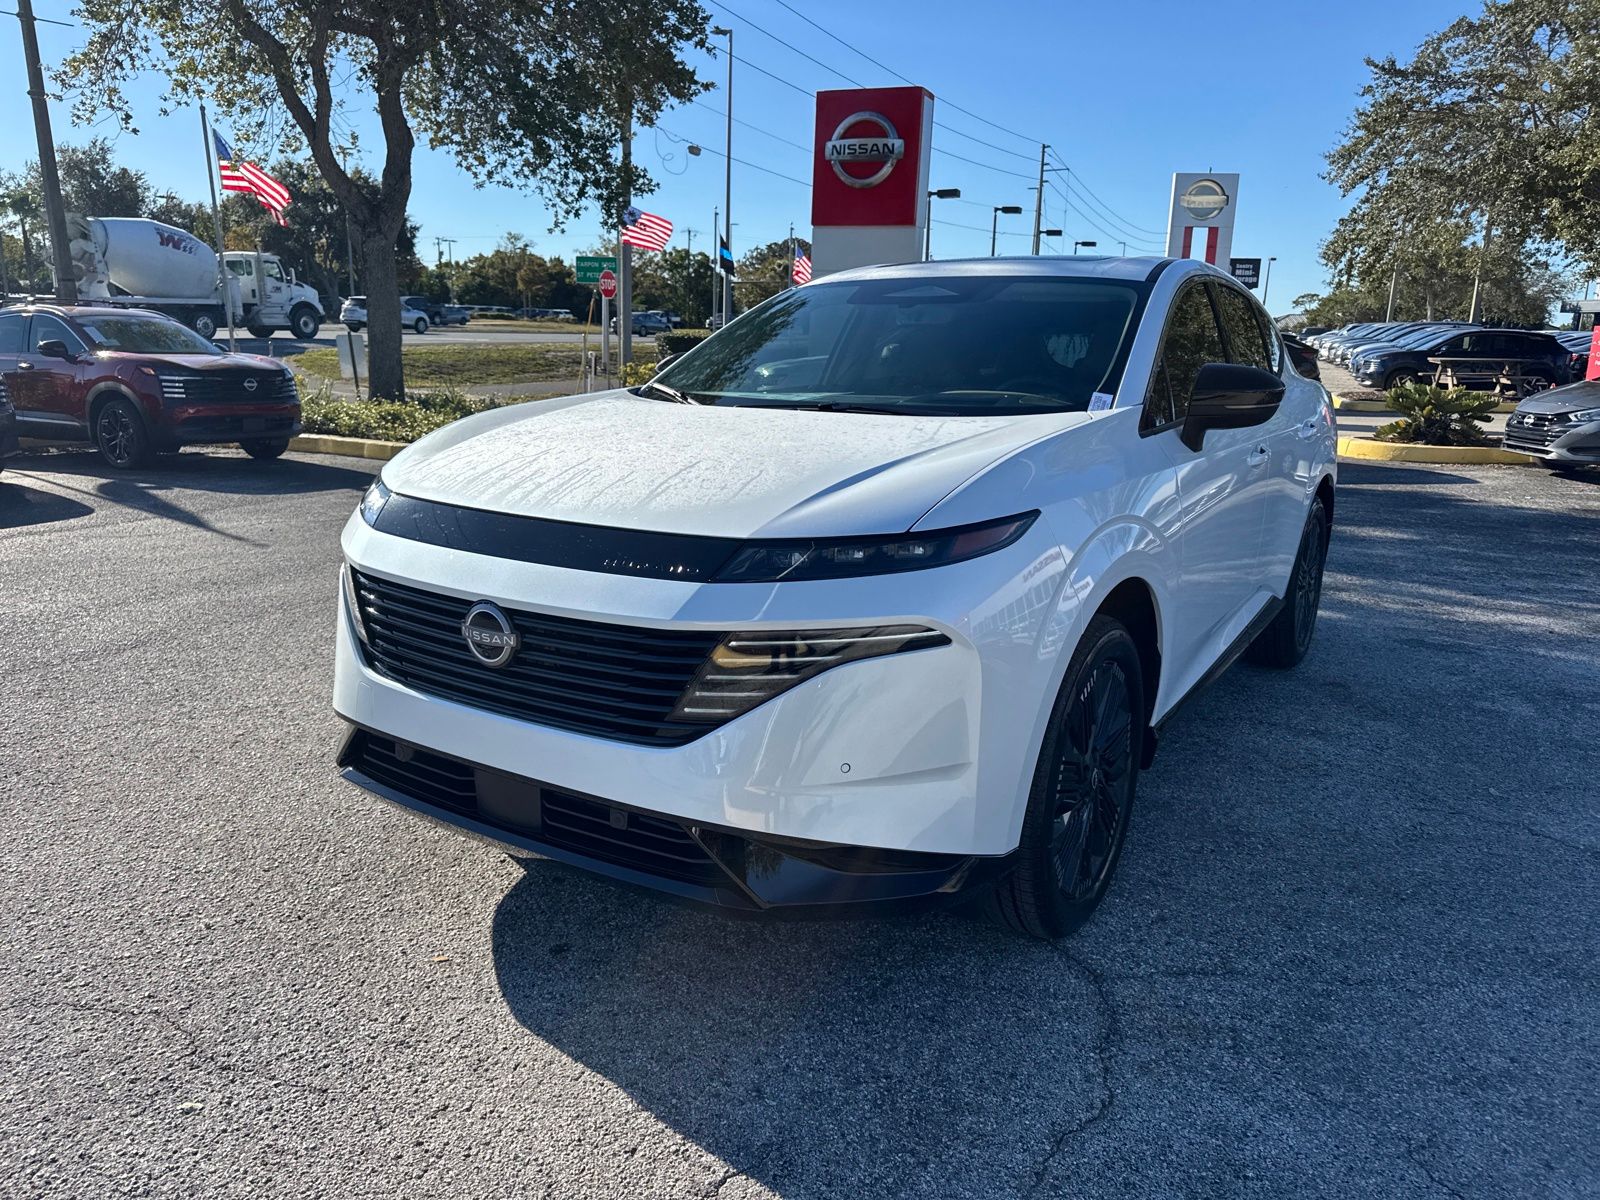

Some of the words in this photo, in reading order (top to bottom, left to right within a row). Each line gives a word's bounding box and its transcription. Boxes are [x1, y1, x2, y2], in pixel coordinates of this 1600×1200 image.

[831, 142, 895, 156] NISSAN
[600, 279, 616, 290] STOP
[462, 625, 514, 645] NISSAN
